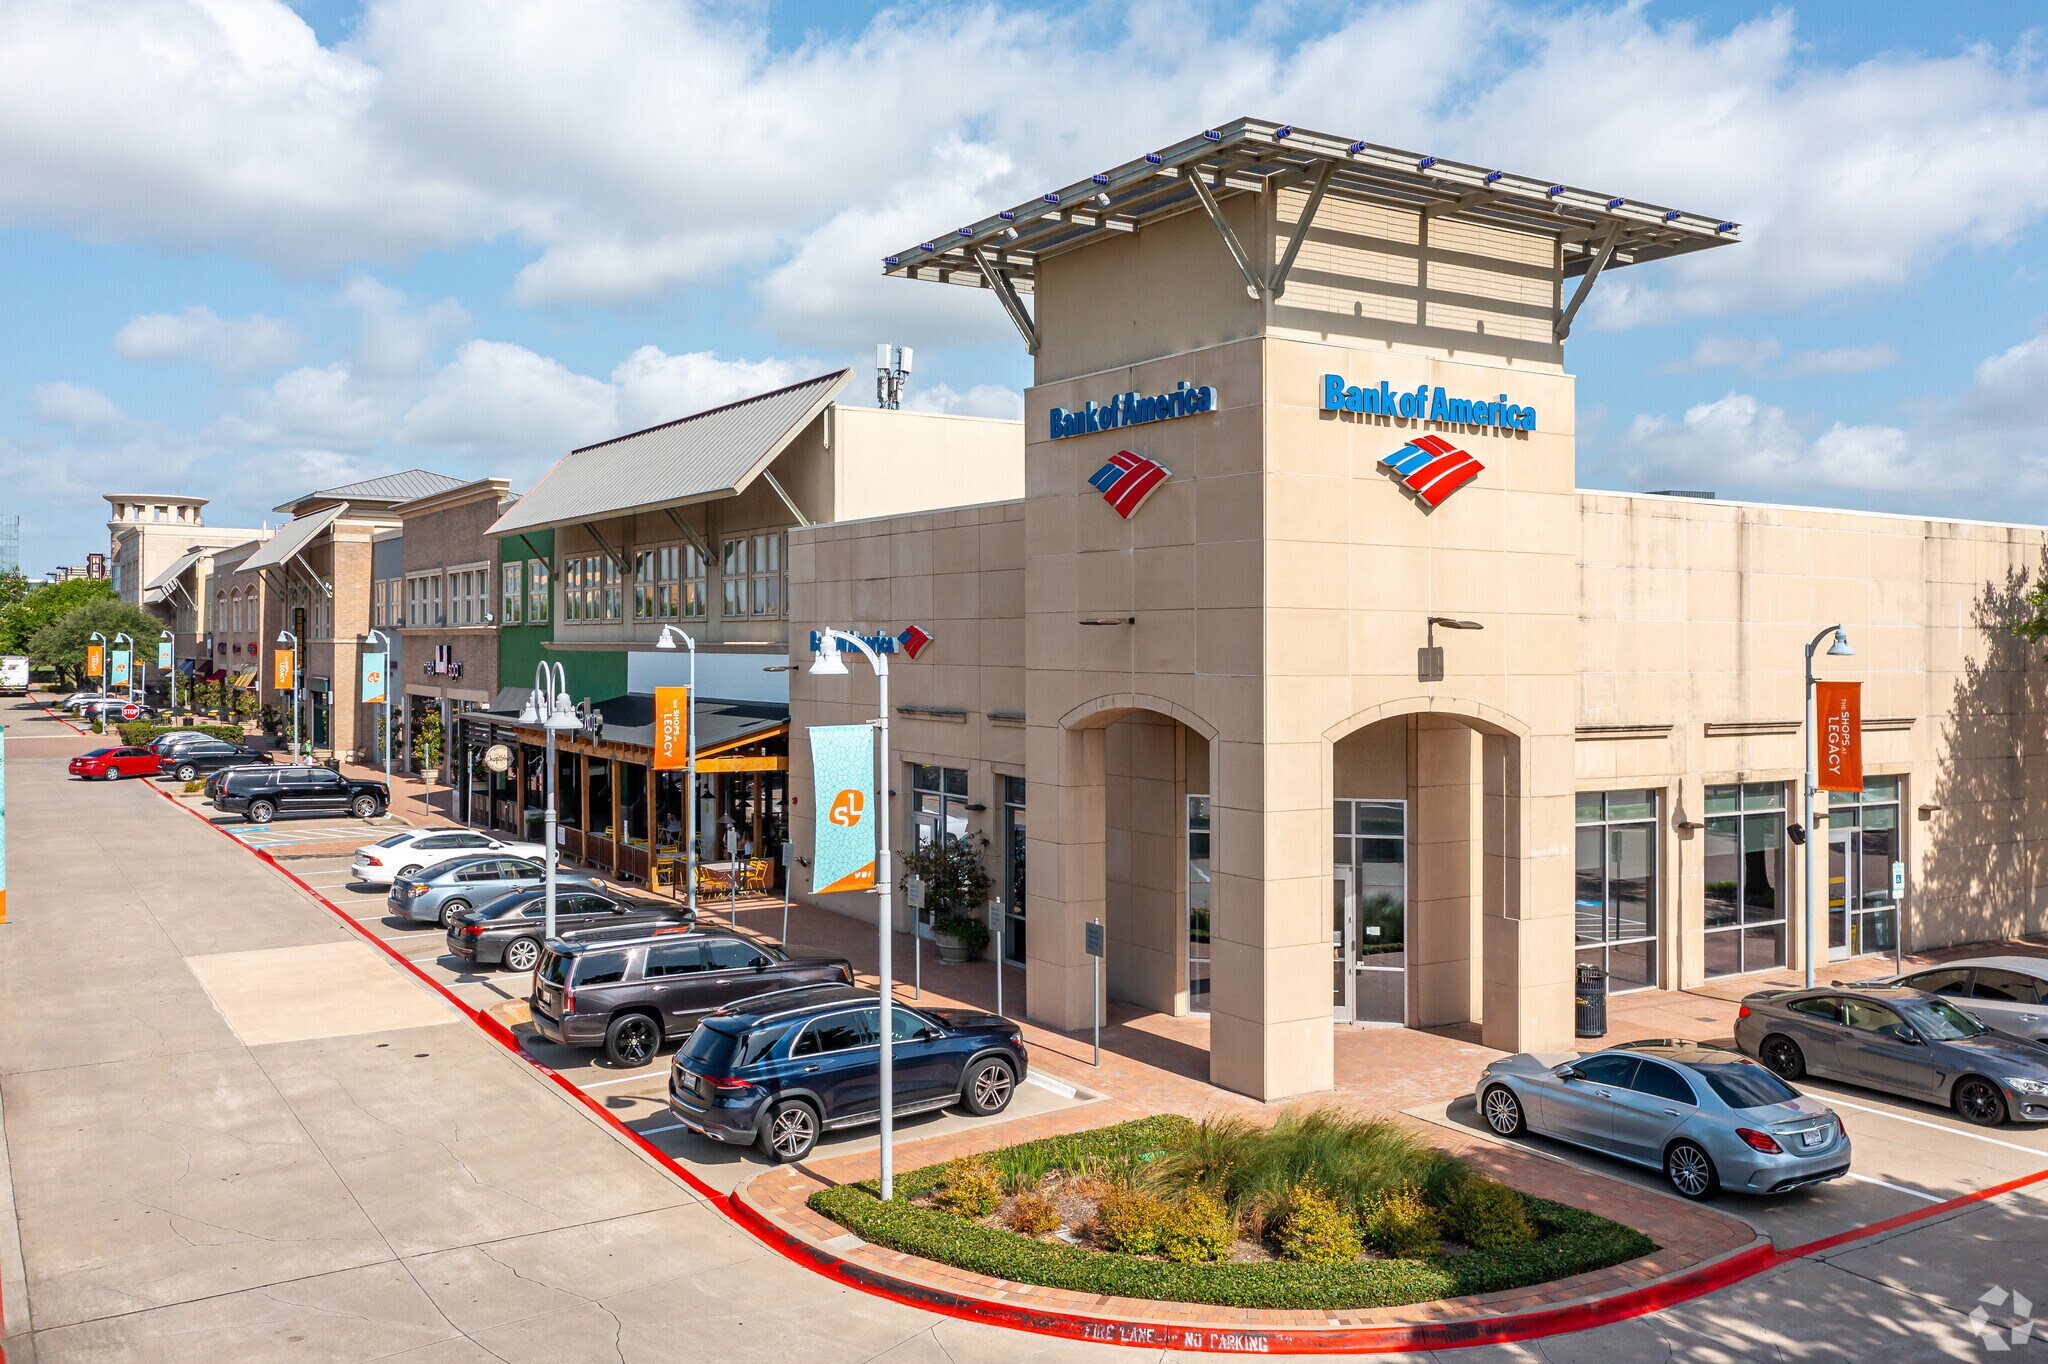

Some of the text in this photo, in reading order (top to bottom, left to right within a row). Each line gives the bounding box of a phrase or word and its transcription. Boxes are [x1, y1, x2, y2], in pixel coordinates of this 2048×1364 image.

[1050, 381, 1215, 439] Bank of America
[1322, 373, 1537, 431] Bank of America
[664, 713, 673, 757] LEGACY
[1828, 716, 1841, 775] LEGACY
[1841, 711, 1850, 745] SHOPS
[1841, 747, 1847, 755] AT
[1083, 1323, 1114, 1340] FIRE
[1119, 1326, 1156, 1343] LANE
[1184, 1331, 1203, 1348] NO
[1209, 1333, 1269, 1353] PARKING
